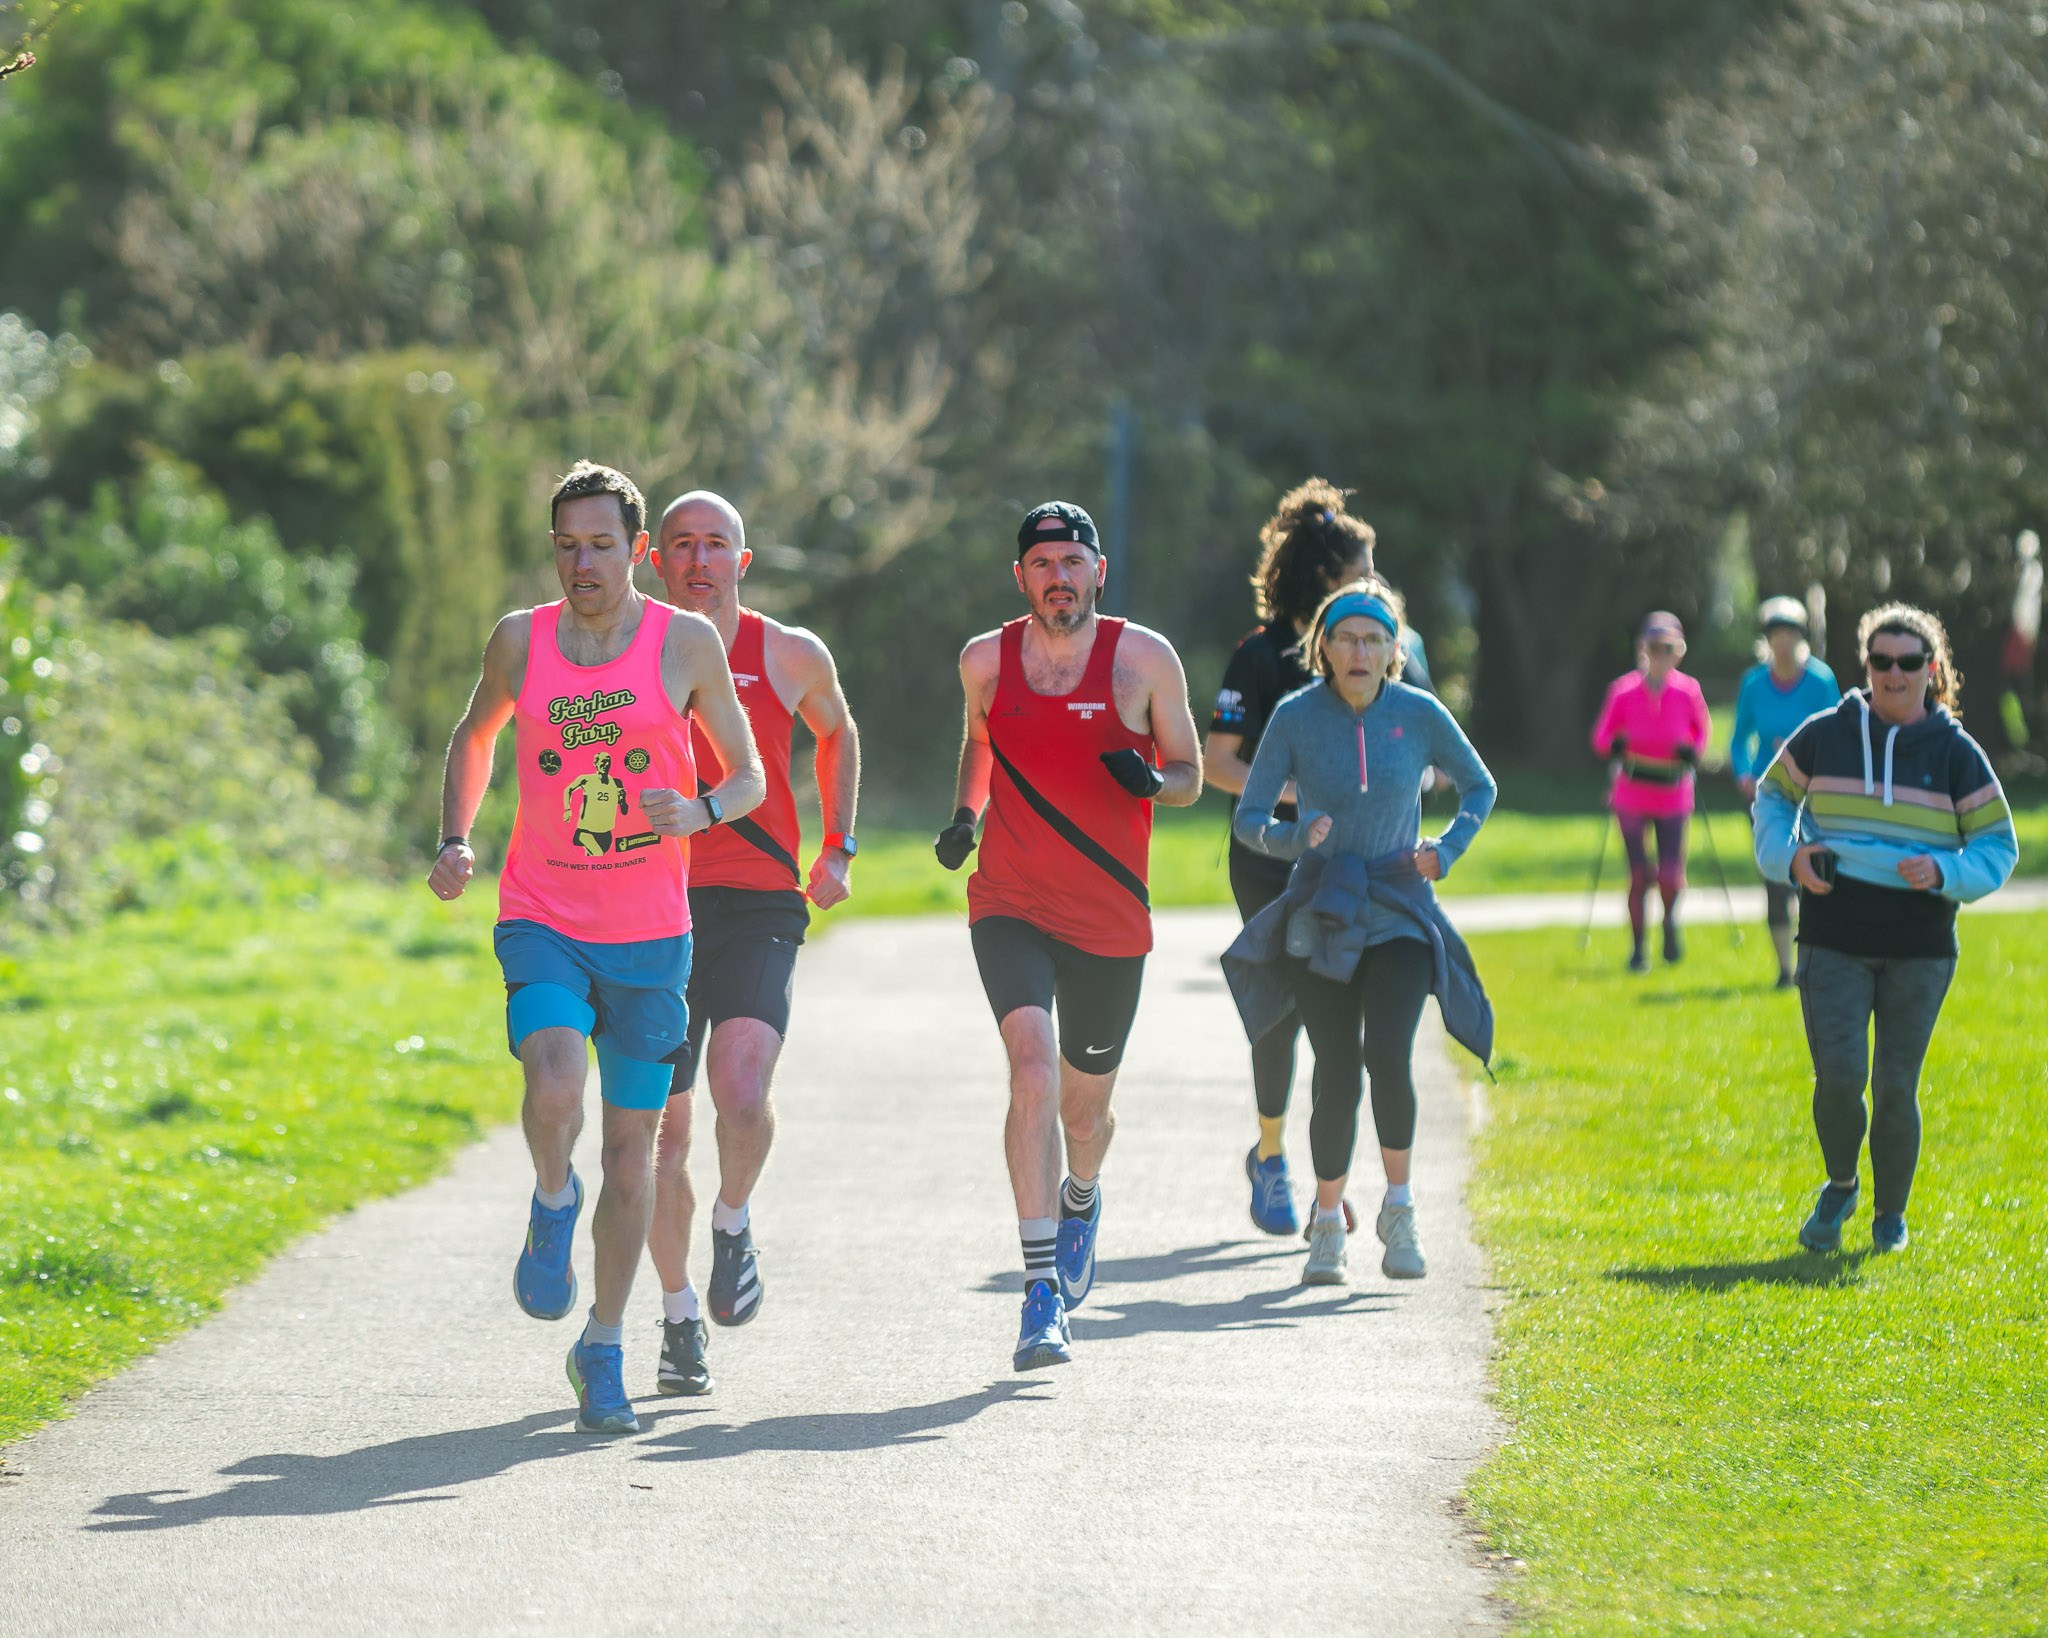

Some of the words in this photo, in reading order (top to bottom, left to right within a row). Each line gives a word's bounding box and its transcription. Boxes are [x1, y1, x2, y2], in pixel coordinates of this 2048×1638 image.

[549, 689, 635, 723] Feighan
[1081, 710, 1092, 719] AC
[562, 722, 621, 749] Fury
[597, 791, 609, 802] 25
[546, 858, 568, 869] SOUTH
[591, 863, 612, 871] ROAD
[614, 857, 647, 869] RUNNERS
